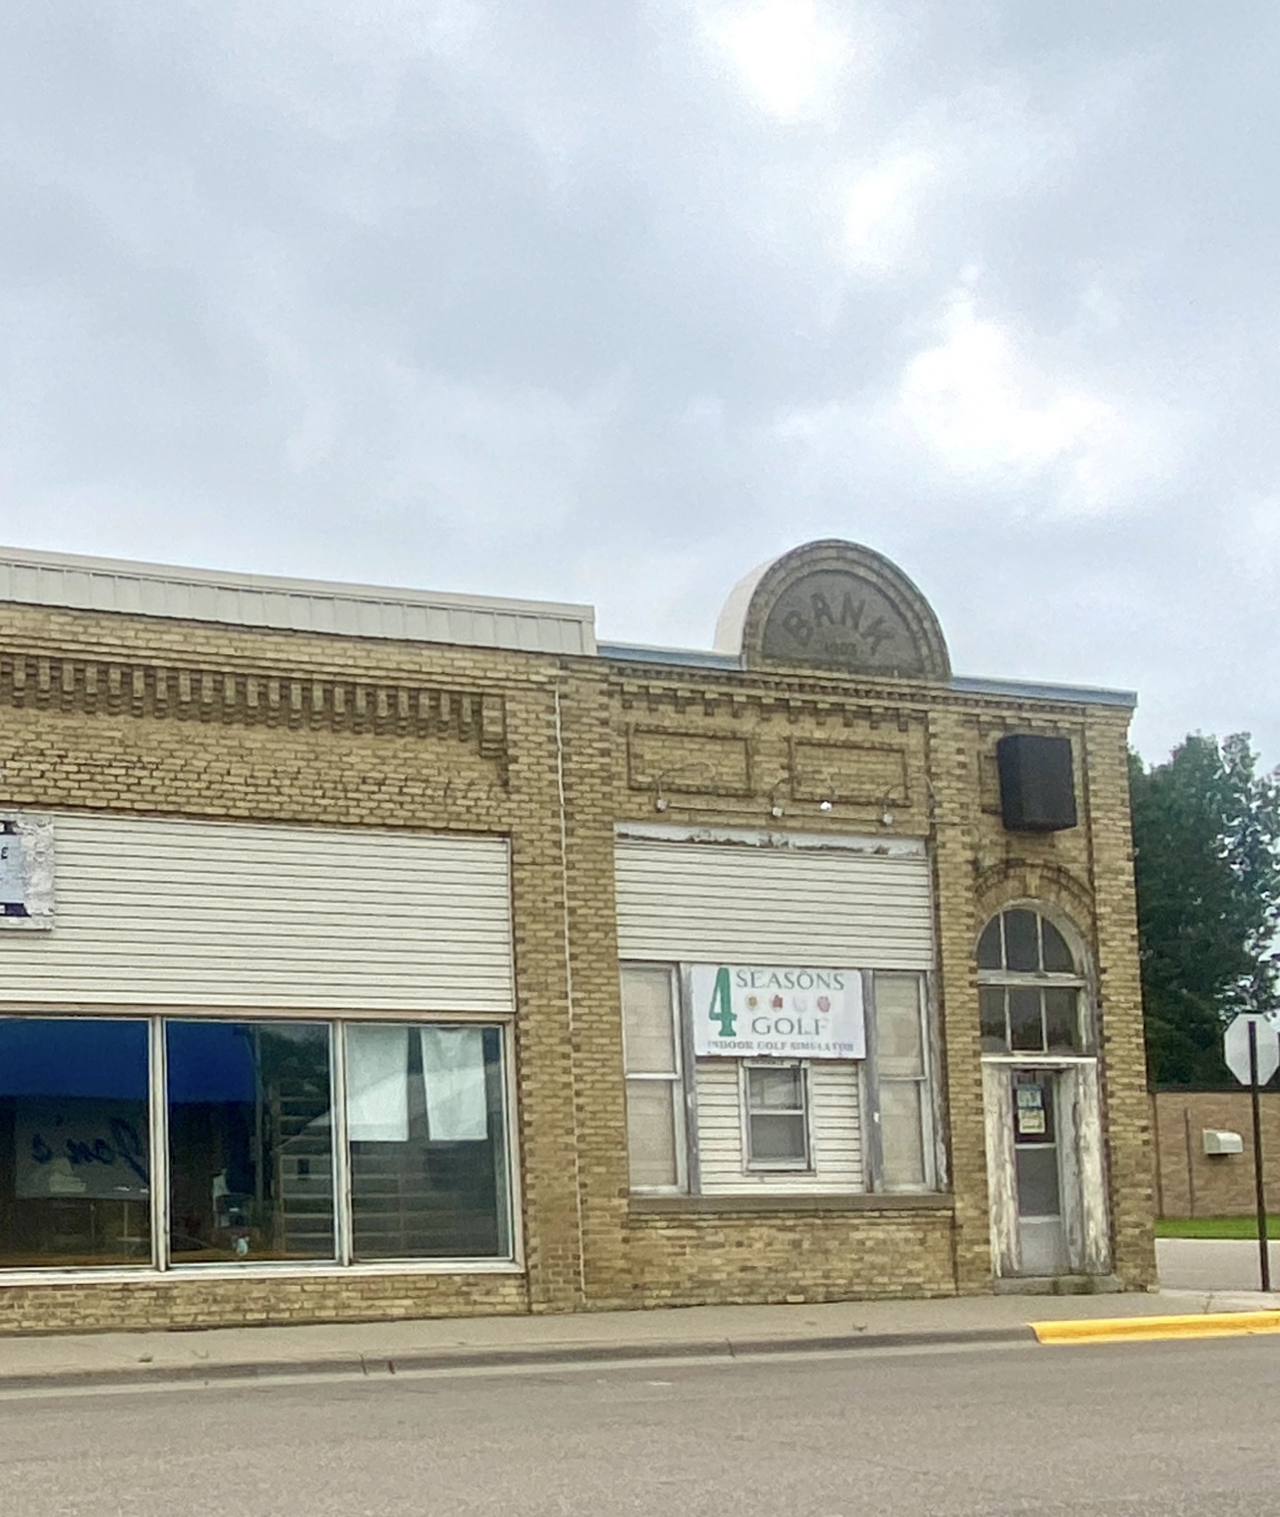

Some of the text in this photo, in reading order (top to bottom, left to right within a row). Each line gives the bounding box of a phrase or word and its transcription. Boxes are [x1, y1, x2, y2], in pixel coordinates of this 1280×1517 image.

[783, 592, 896, 656] BANK
[709, 967, 844, 1037] 4 SEASONS
[708, 1041, 754, 1050] INDOOR
[758, 1041, 787, 1050] GOLF
[751, 1016, 828, 1036] GOLF
